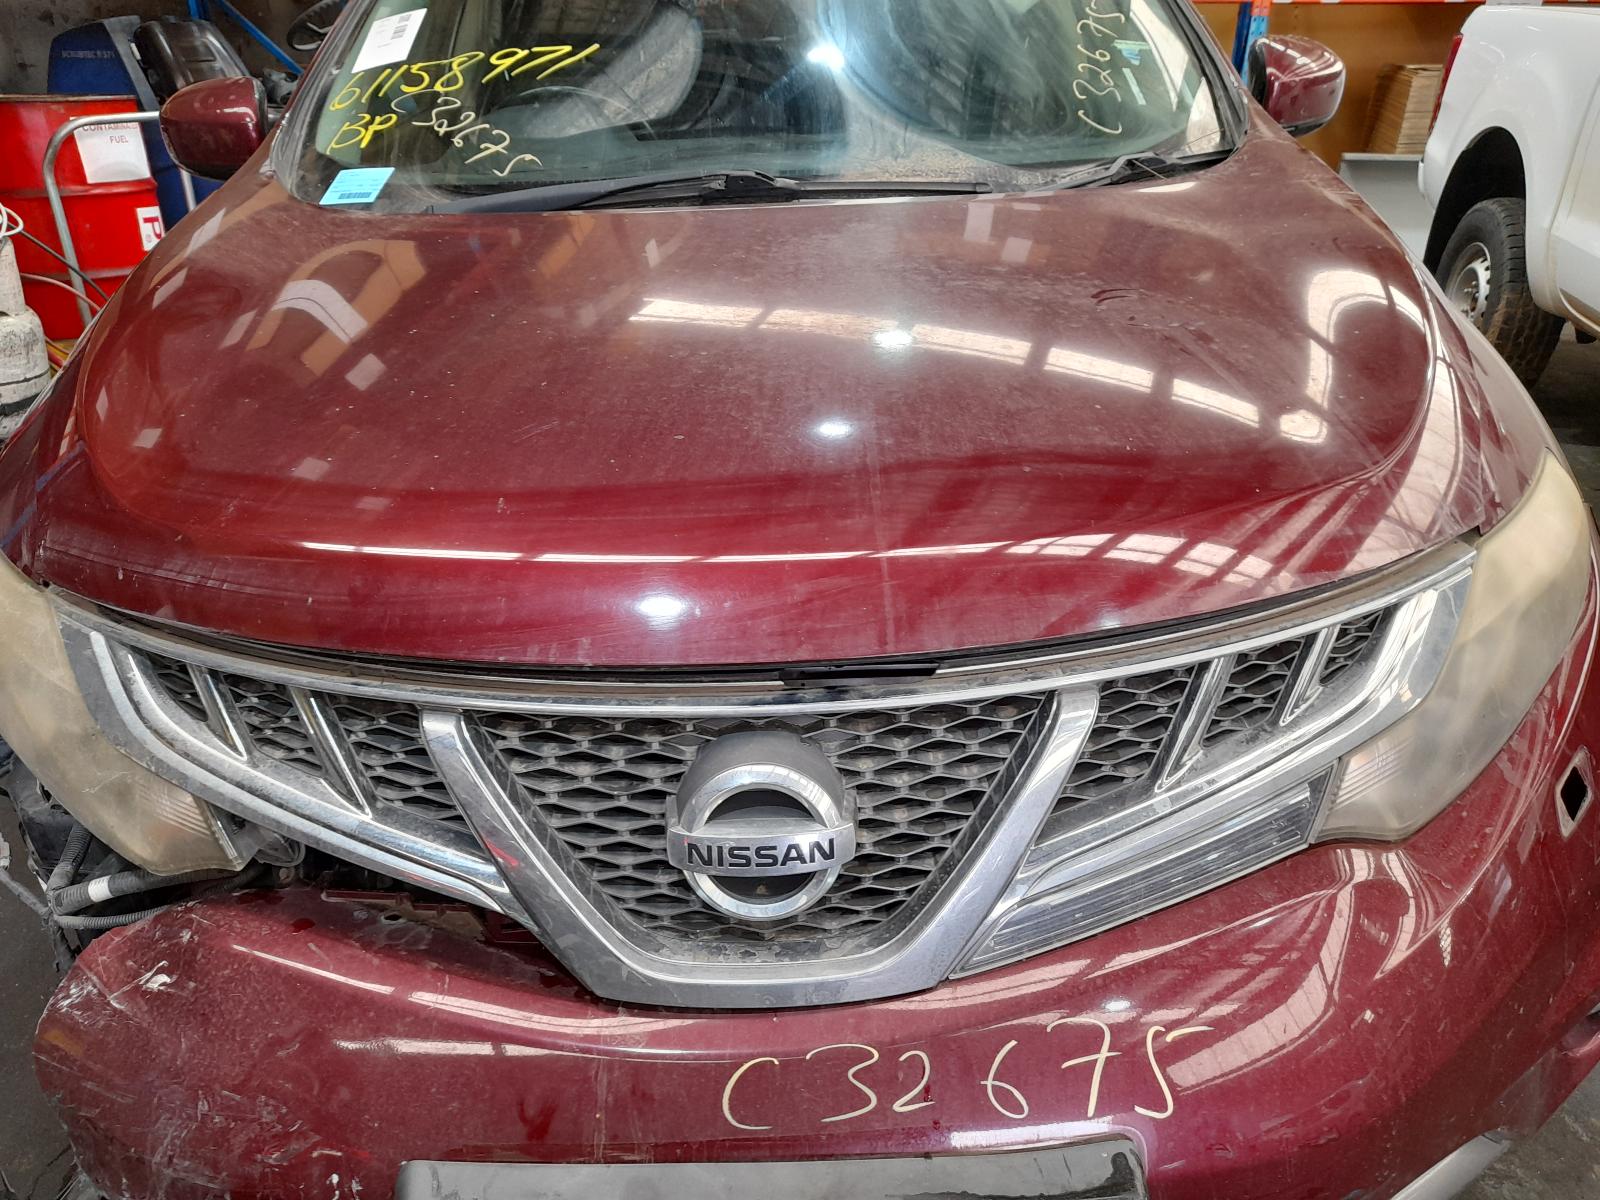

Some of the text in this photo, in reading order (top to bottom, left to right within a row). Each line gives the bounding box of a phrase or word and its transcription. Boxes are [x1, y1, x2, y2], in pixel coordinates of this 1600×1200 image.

[109, 135, 129, 144] FUEL
[326, 113, 397, 154] BP
[687, 838, 835, 868] NISSAN
